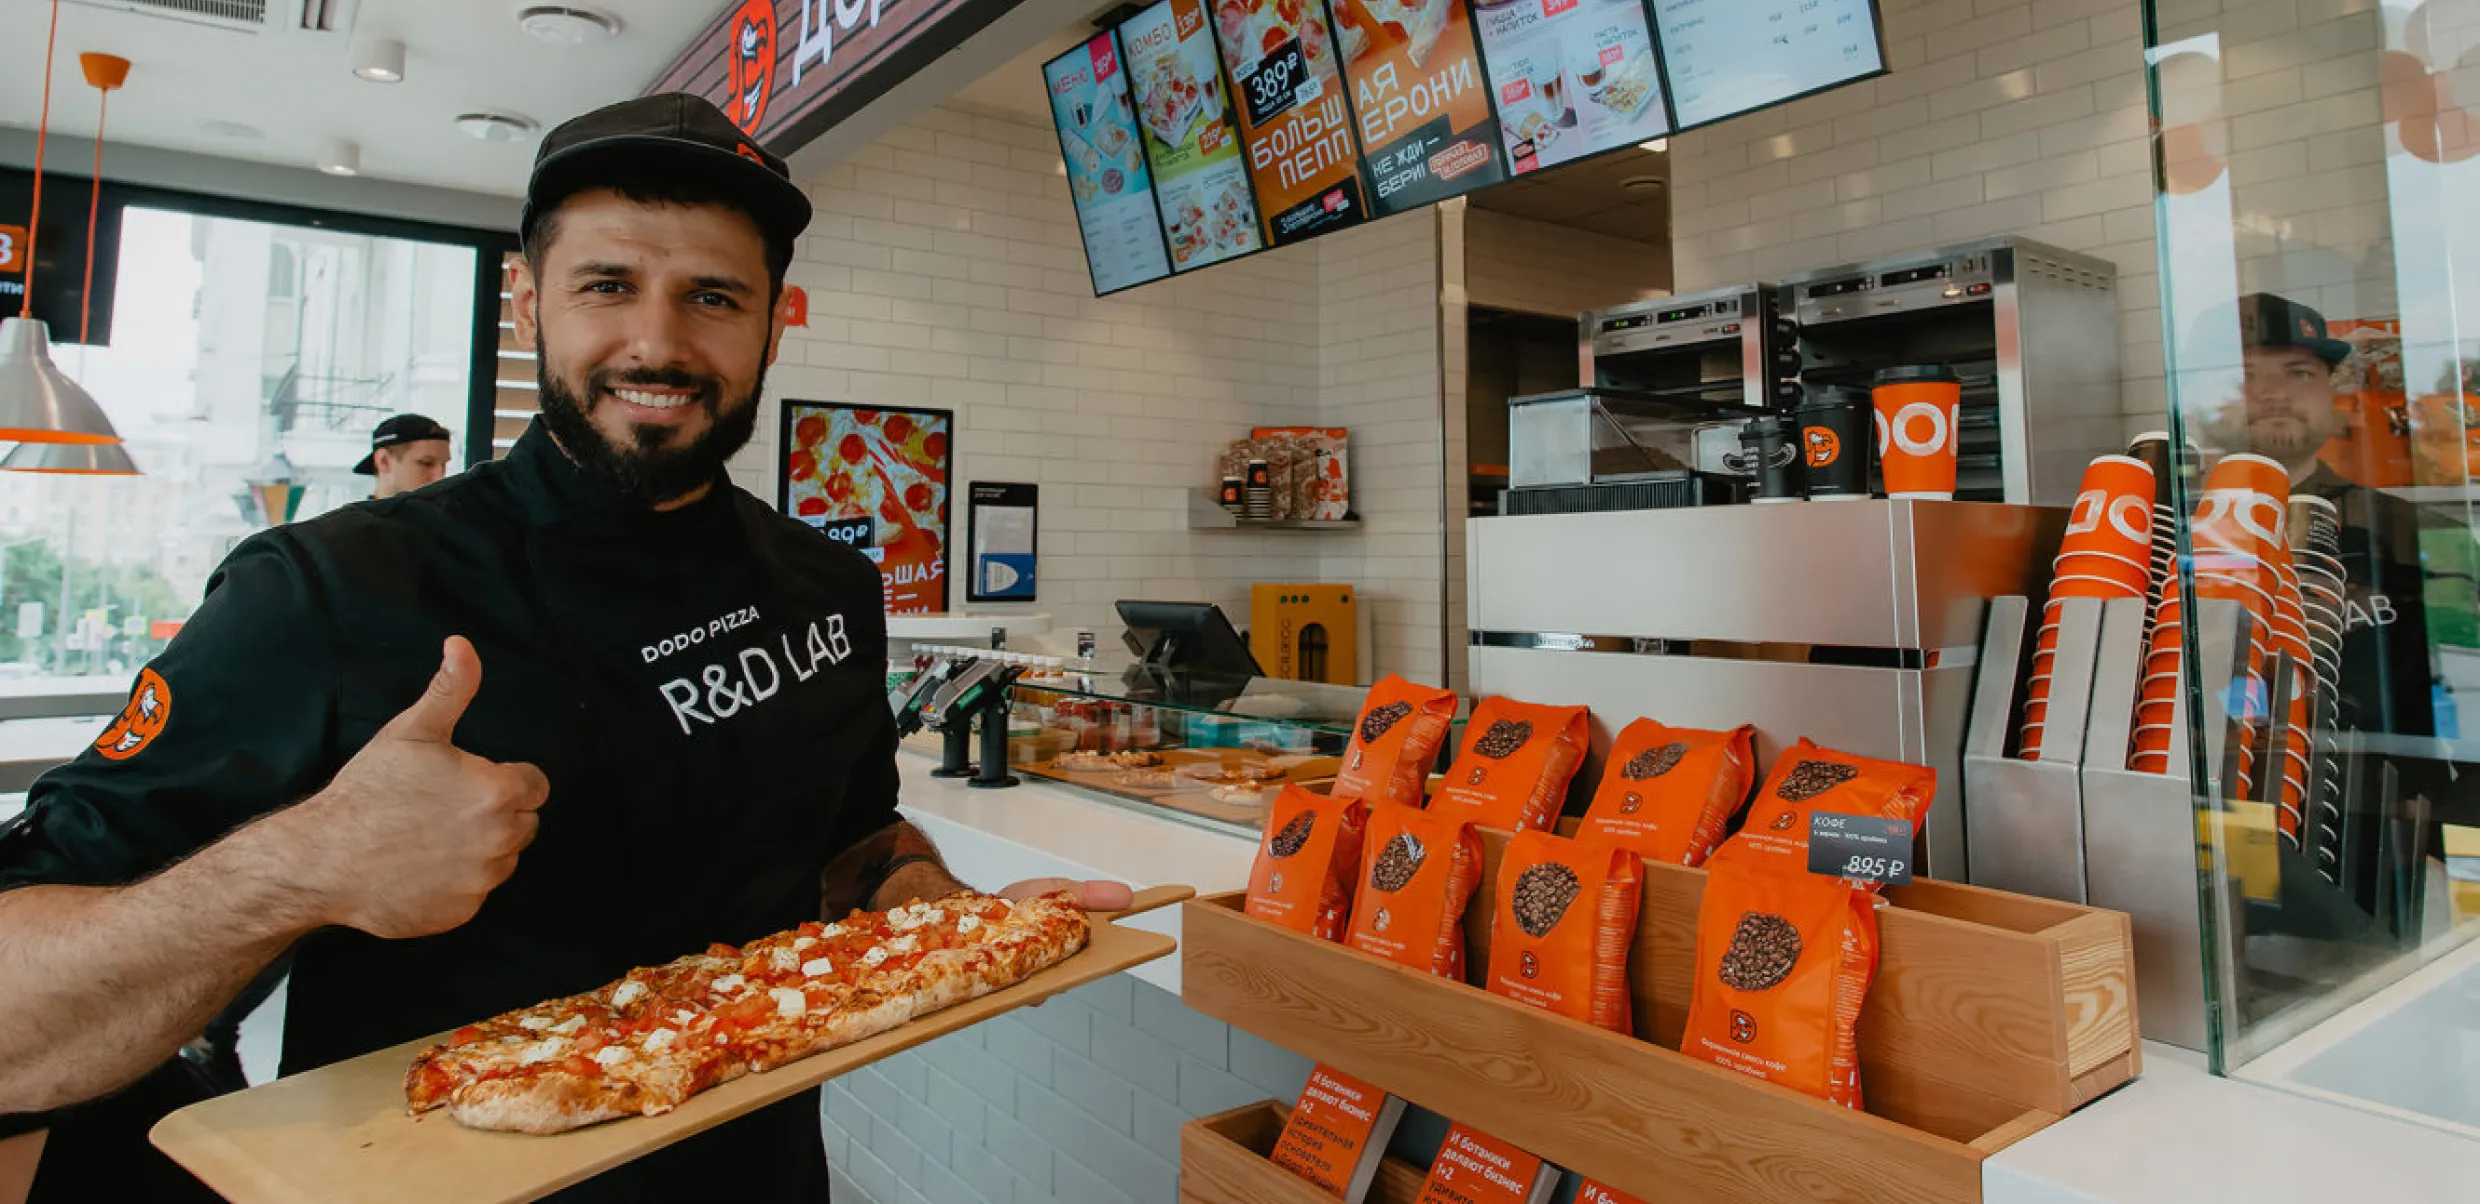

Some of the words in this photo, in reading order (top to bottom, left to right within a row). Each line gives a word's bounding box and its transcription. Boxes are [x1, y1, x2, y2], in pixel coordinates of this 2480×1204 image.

[1358, 59, 1399, 111] АЯ
[1361, 57, 1474, 145] ЕРОНИ
[1250, 93, 1344, 171] БОЛЬШ
[1278, 127, 1352, 191] ПЕПП
[1372, 155, 1395, 178] НЕ
[640, 626, 706, 664] DODO
[708, 604, 761, 638] PIZZA
[658, 646, 781, 736] R&D
[781, 612, 852, 682] LAB
[1813, 816, 1847, 829] КОФЕ
